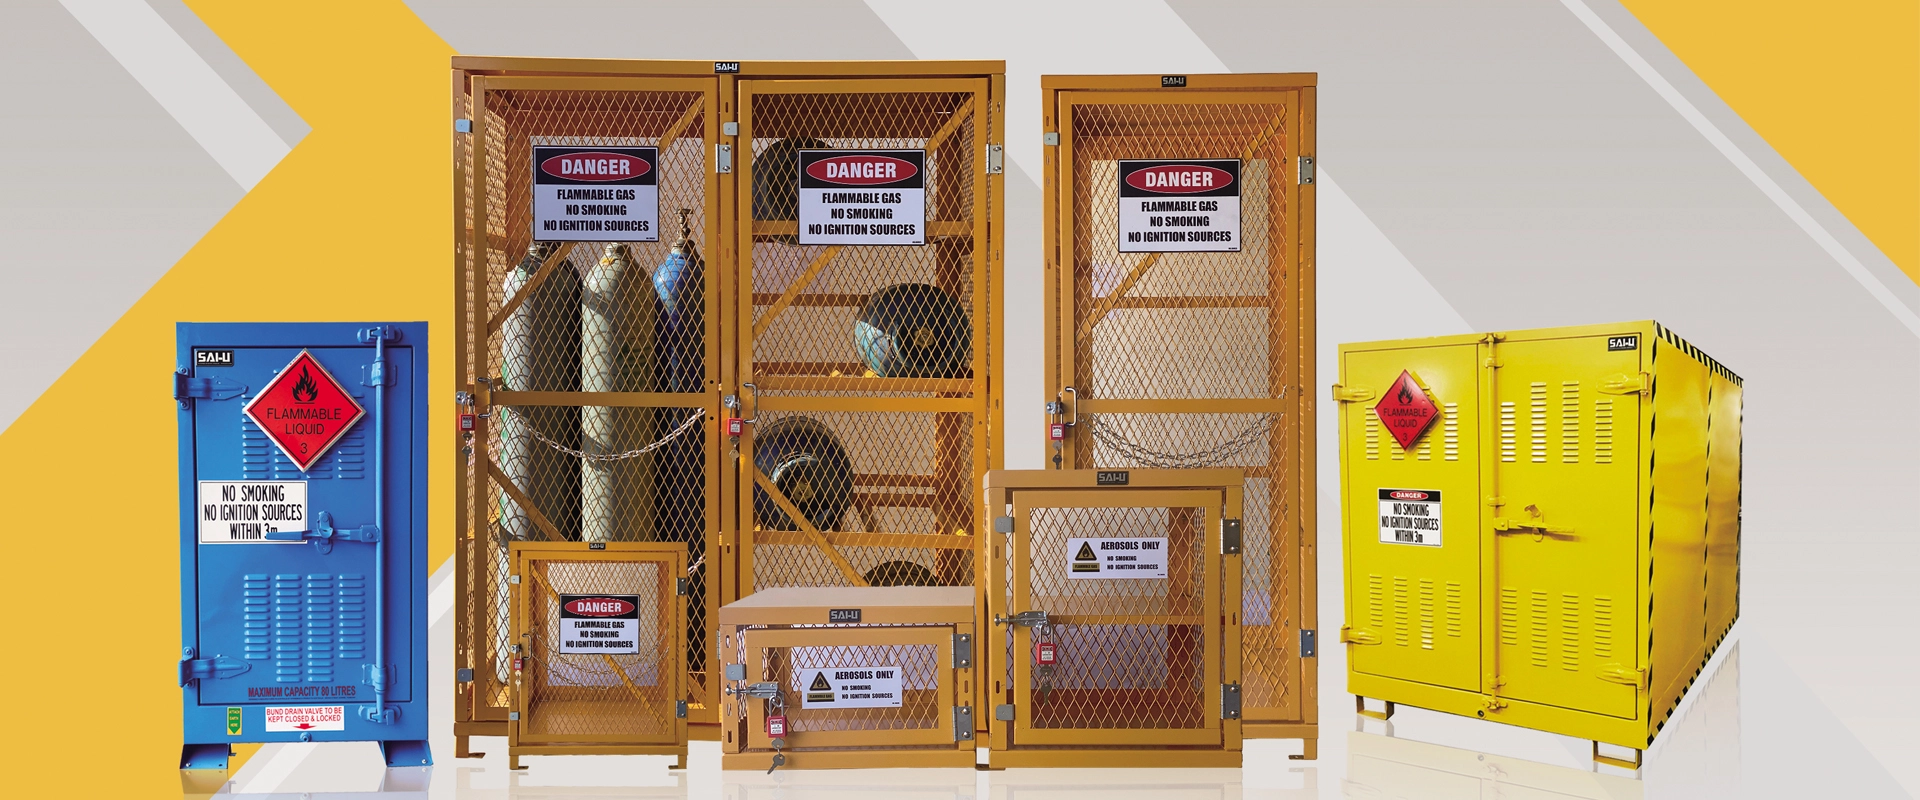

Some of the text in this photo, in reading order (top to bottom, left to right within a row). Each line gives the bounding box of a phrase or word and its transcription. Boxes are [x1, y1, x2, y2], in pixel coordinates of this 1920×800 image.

[561, 159, 630, 174] DANGER
[826, 162, 897, 178] DANGER
[1146, 171, 1213, 187] DANGER
[557, 189, 635, 200] FLAMMABLE GAS
[822, 193, 901, 204] FLAMMABLE GAS
[566, 204, 627, 215] NO SMOKING
[1142, 201, 1218, 212] FLAMMABLE GAS
[831, 208, 893, 219] NO SMOKING
[544, 220, 649, 231] NO IGNITION SOURCES
[1150, 216, 1210, 227] NO SMOKING
[808, 224, 916, 235] NO IGNITION SOURCES
[1128, 231, 1232, 242] NO IGNITION SOURCES
[1610, 338, 1635, 348] SAI-U
[198, 352, 231, 362] SAI-U
[266, 408, 342, 420] FLAMMABLE
[1383, 408, 1427, 417] FLAMMABLE
[1394, 419, 1417, 428] LIQUID
[286, 424, 324, 435] LIQUID
[1402, 433, 1408, 441] 3
[300, 443, 307, 454] 3
[1099, 473, 1126, 481] SAI-U
[222, 485, 285, 502] NO SMOKING
[204, 504, 302, 521] NO IGNITION SOURCES
[1393, 503, 1429, 516] NO SMOKING
[1382, 516, 1439, 531] NO IGNITION SOURCES
[230, 523, 261, 539] WITHIN
[1395, 530, 1423, 543] WITHIN 3m
[1101, 541, 1160, 550] AEROSOLS ONLY
[577, 602, 622, 613] DANGER
[831, 611, 858, 619] SAI-U
[566, 640, 633, 648] NO IGNITION SOURCES
[835, 671, 894, 680] AEROSOLS ONLY
[248, 686, 356, 697] MAXIMUM CAPACITY 80 LITRES
